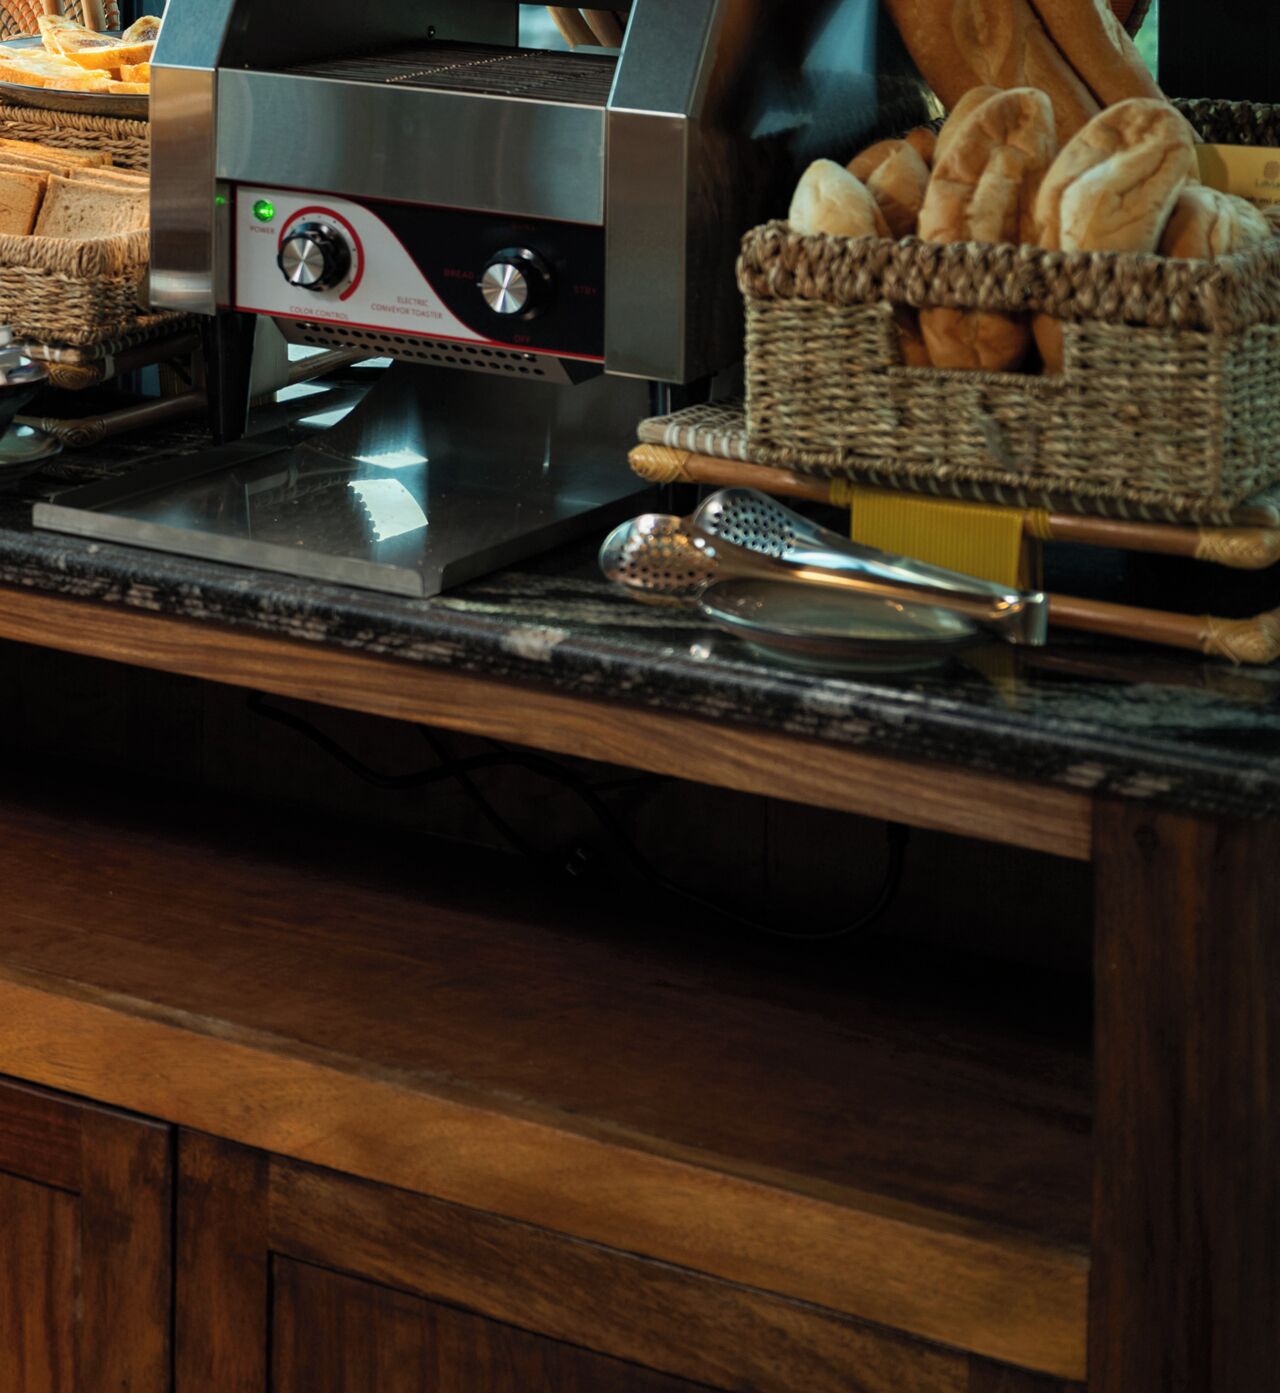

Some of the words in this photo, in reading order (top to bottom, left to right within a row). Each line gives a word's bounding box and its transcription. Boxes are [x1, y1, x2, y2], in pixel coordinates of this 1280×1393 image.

[250, 225, 275, 235] POWER
[443, 268, 474, 279] BREAD
[397, 296, 428, 307] ELECTRIC
[290, 306, 313, 315] COLOR
[315, 308, 349, 320] CONTROL
[371, 303, 409, 315] CONVEYOR
[411, 308, 443, 320] TOASTER
